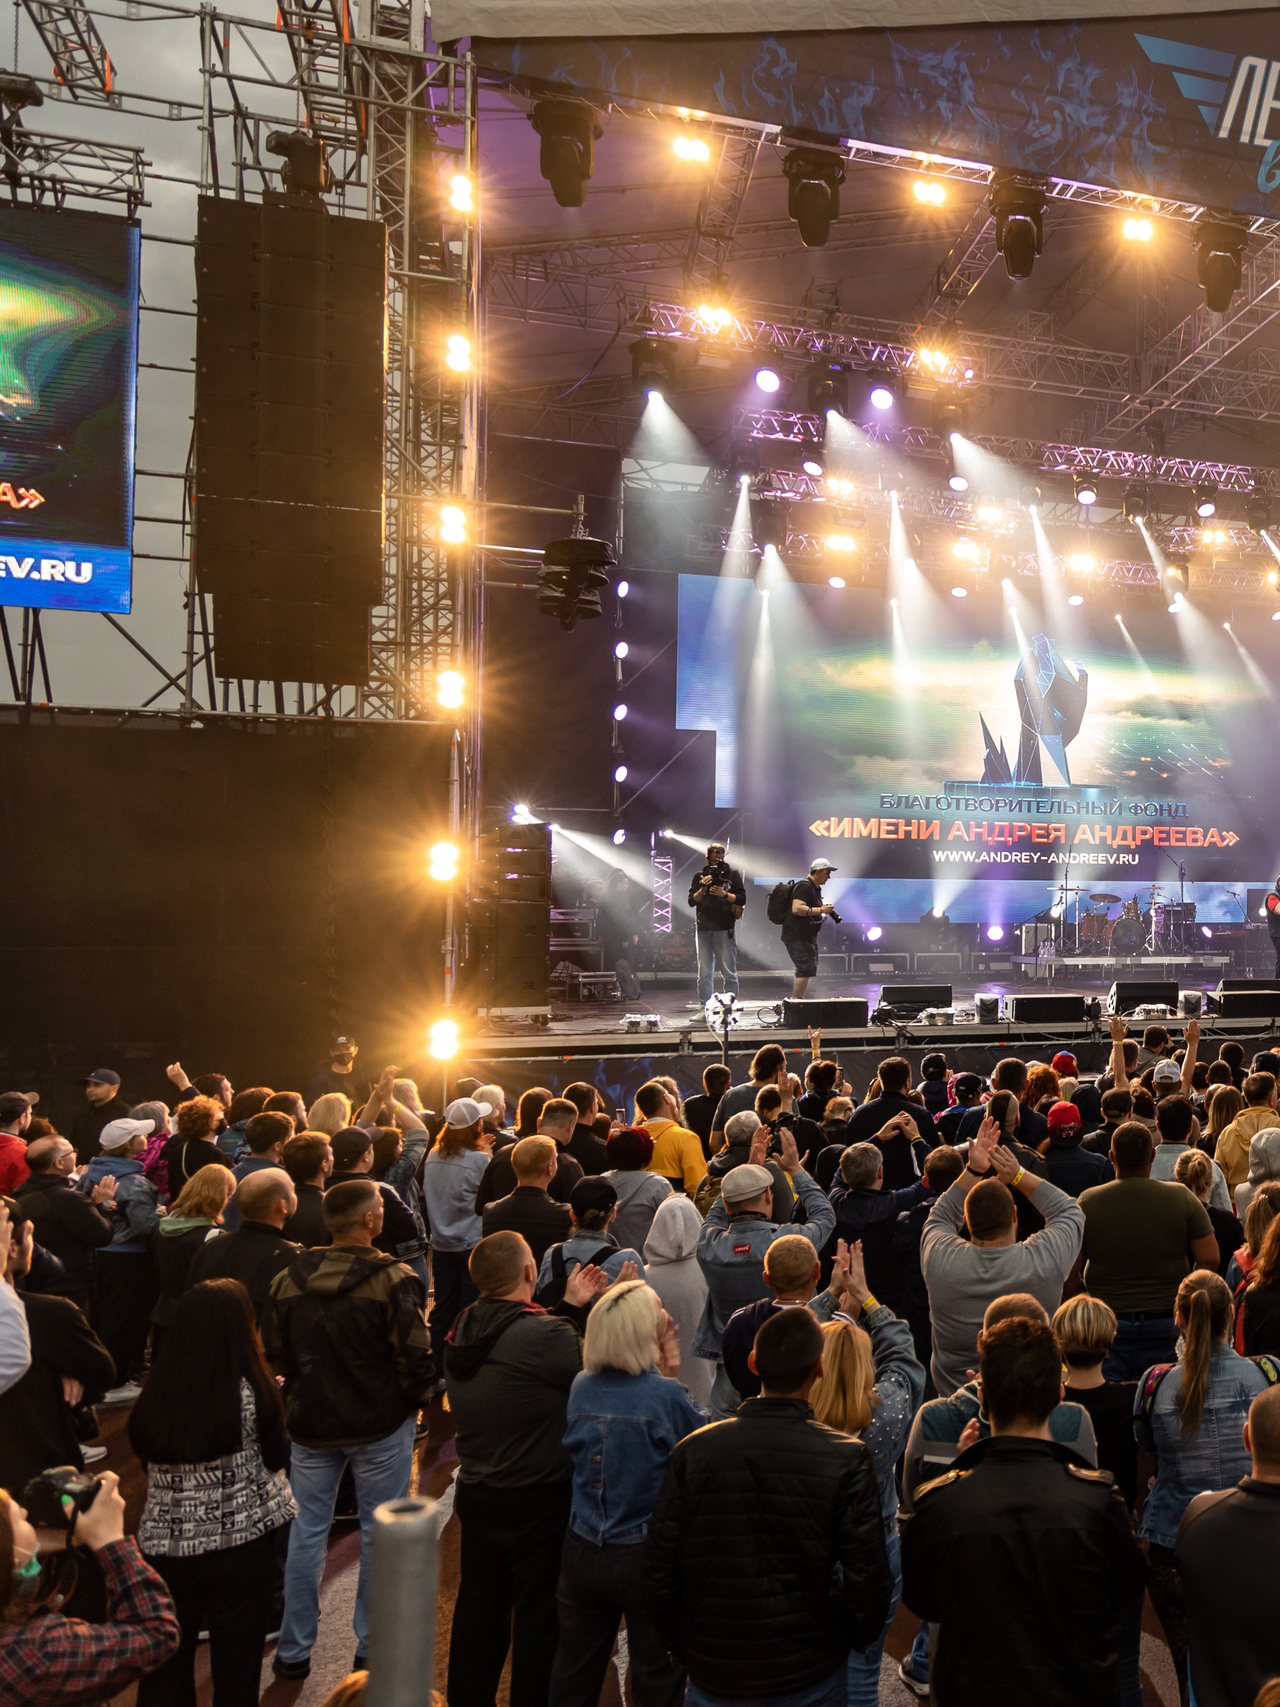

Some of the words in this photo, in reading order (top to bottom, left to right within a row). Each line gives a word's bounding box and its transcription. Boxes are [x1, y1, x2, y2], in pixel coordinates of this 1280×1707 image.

[880, 793, 1123, 817] БЛАГОТВОРИТЕЛЬНЫЙ
[1128, 802, 1190, 819] ФОНД
[809, 816, 941, 841] «ИМЕНИ
[947, 820, 1066, 846] АНДРЕЯ
[1073, 824, 1240, 849] АНДРЕЕВА»
[932, 850, 1140, 865] WWW.ANDREY-ANDREEV.RU
